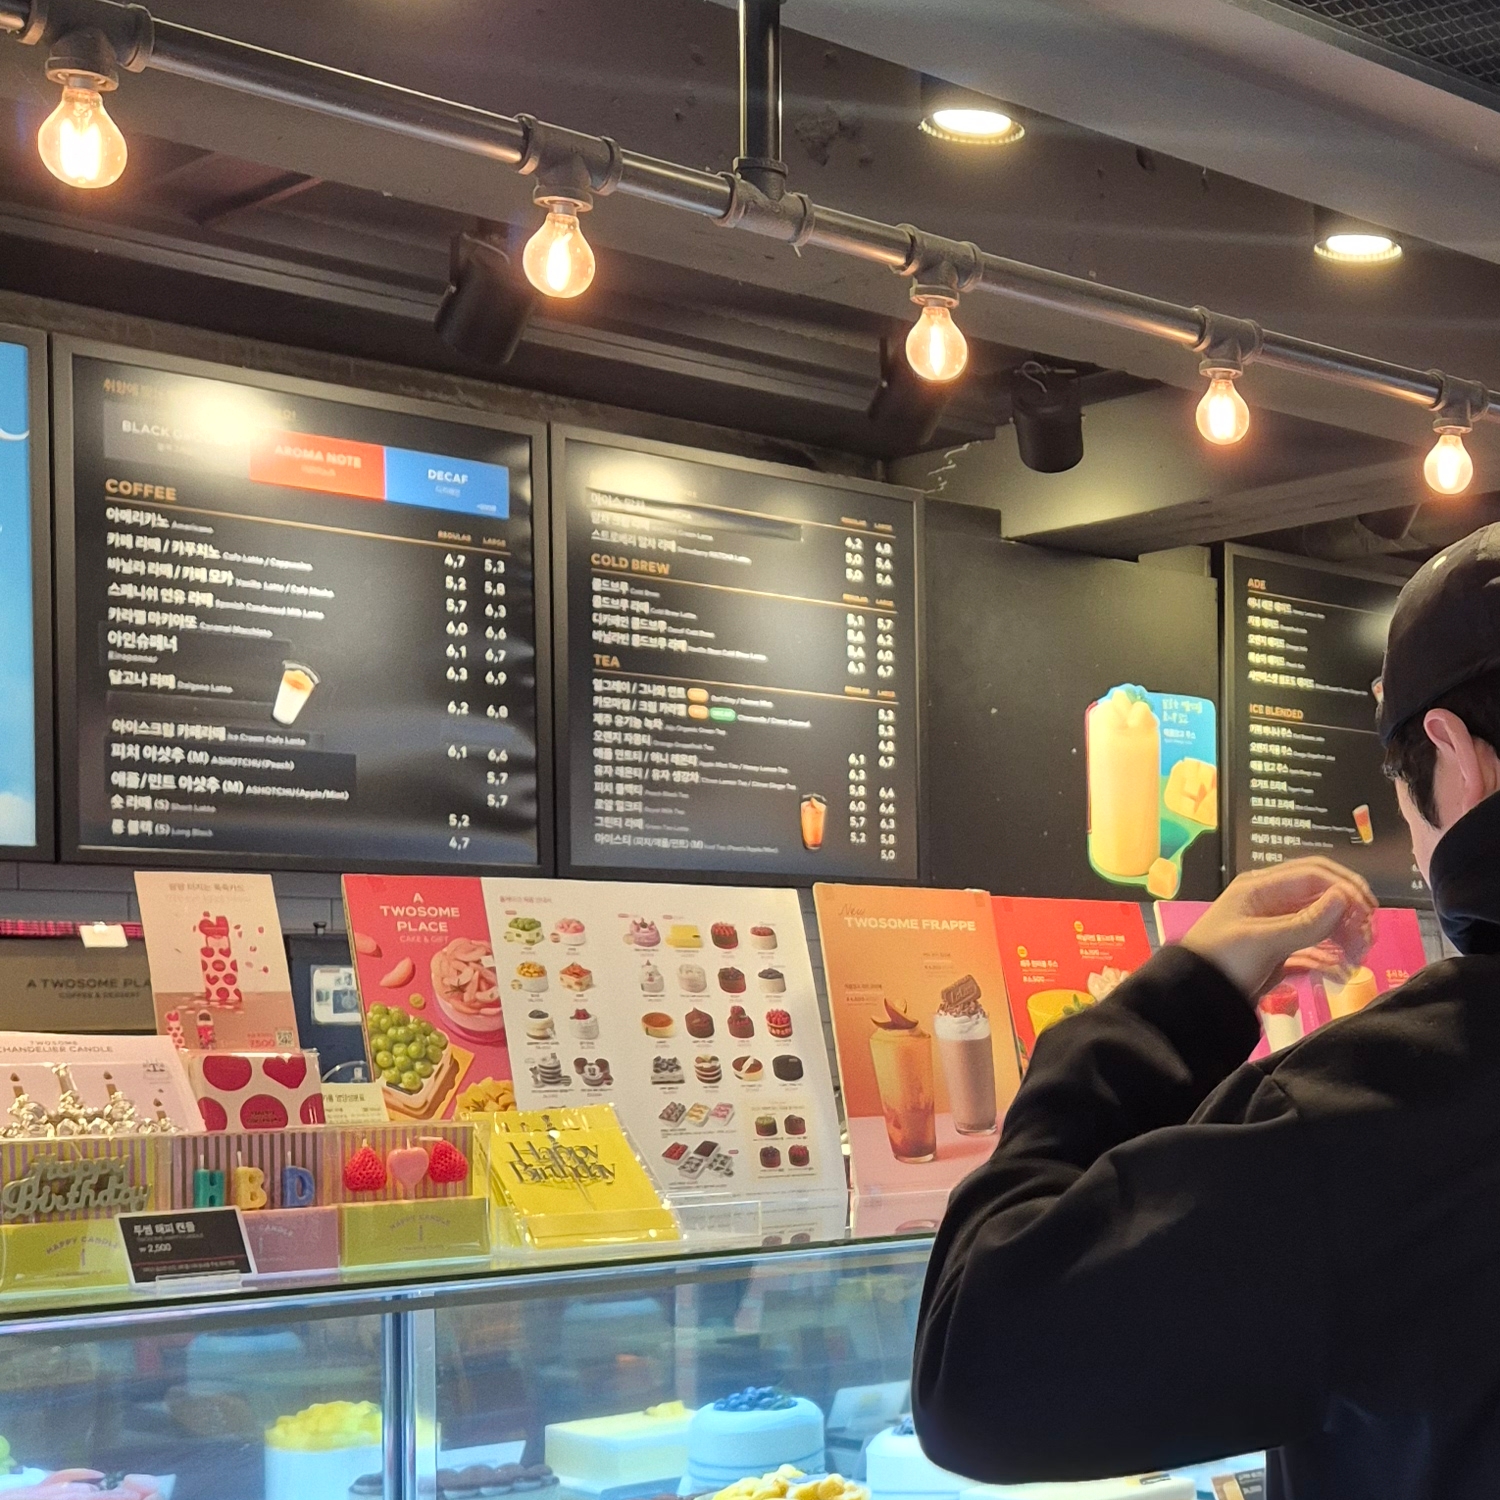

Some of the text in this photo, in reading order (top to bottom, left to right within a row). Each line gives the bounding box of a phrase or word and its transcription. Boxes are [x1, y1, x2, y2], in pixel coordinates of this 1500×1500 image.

[122, 420, 170, 437] BLACK
[275, 444, 361, 468] AROMA NOTE
[428, 469, 468, 483] DECAF
[105, 479, 176, 500] COFFEE
[106, 507, 170, 528] 아메리카노
[591, 553, 670, 574] COLD BREW
[1247, 578, 1266, 590] ADE
[593, 653, 621, 668] TEA
[1249, 703, 1304, 720] ICE BLENDED
[413, 892, 424, 904] A
[380, 905, 460, 918] TWOSOME
[838, 903, 866, 916] New
[396, 921, 448, 933] PLACE
[844, 916, 976, 931] TWOSOME FRAPPE
[26, 979, 37, 988] A
[41, 978, 117, 989] TWOSOME
[507, 1140, 599, 1168] Happy
[2, 1176, 151, 1219] Birthday
[147, 1243, 172, 1254] 2,500
